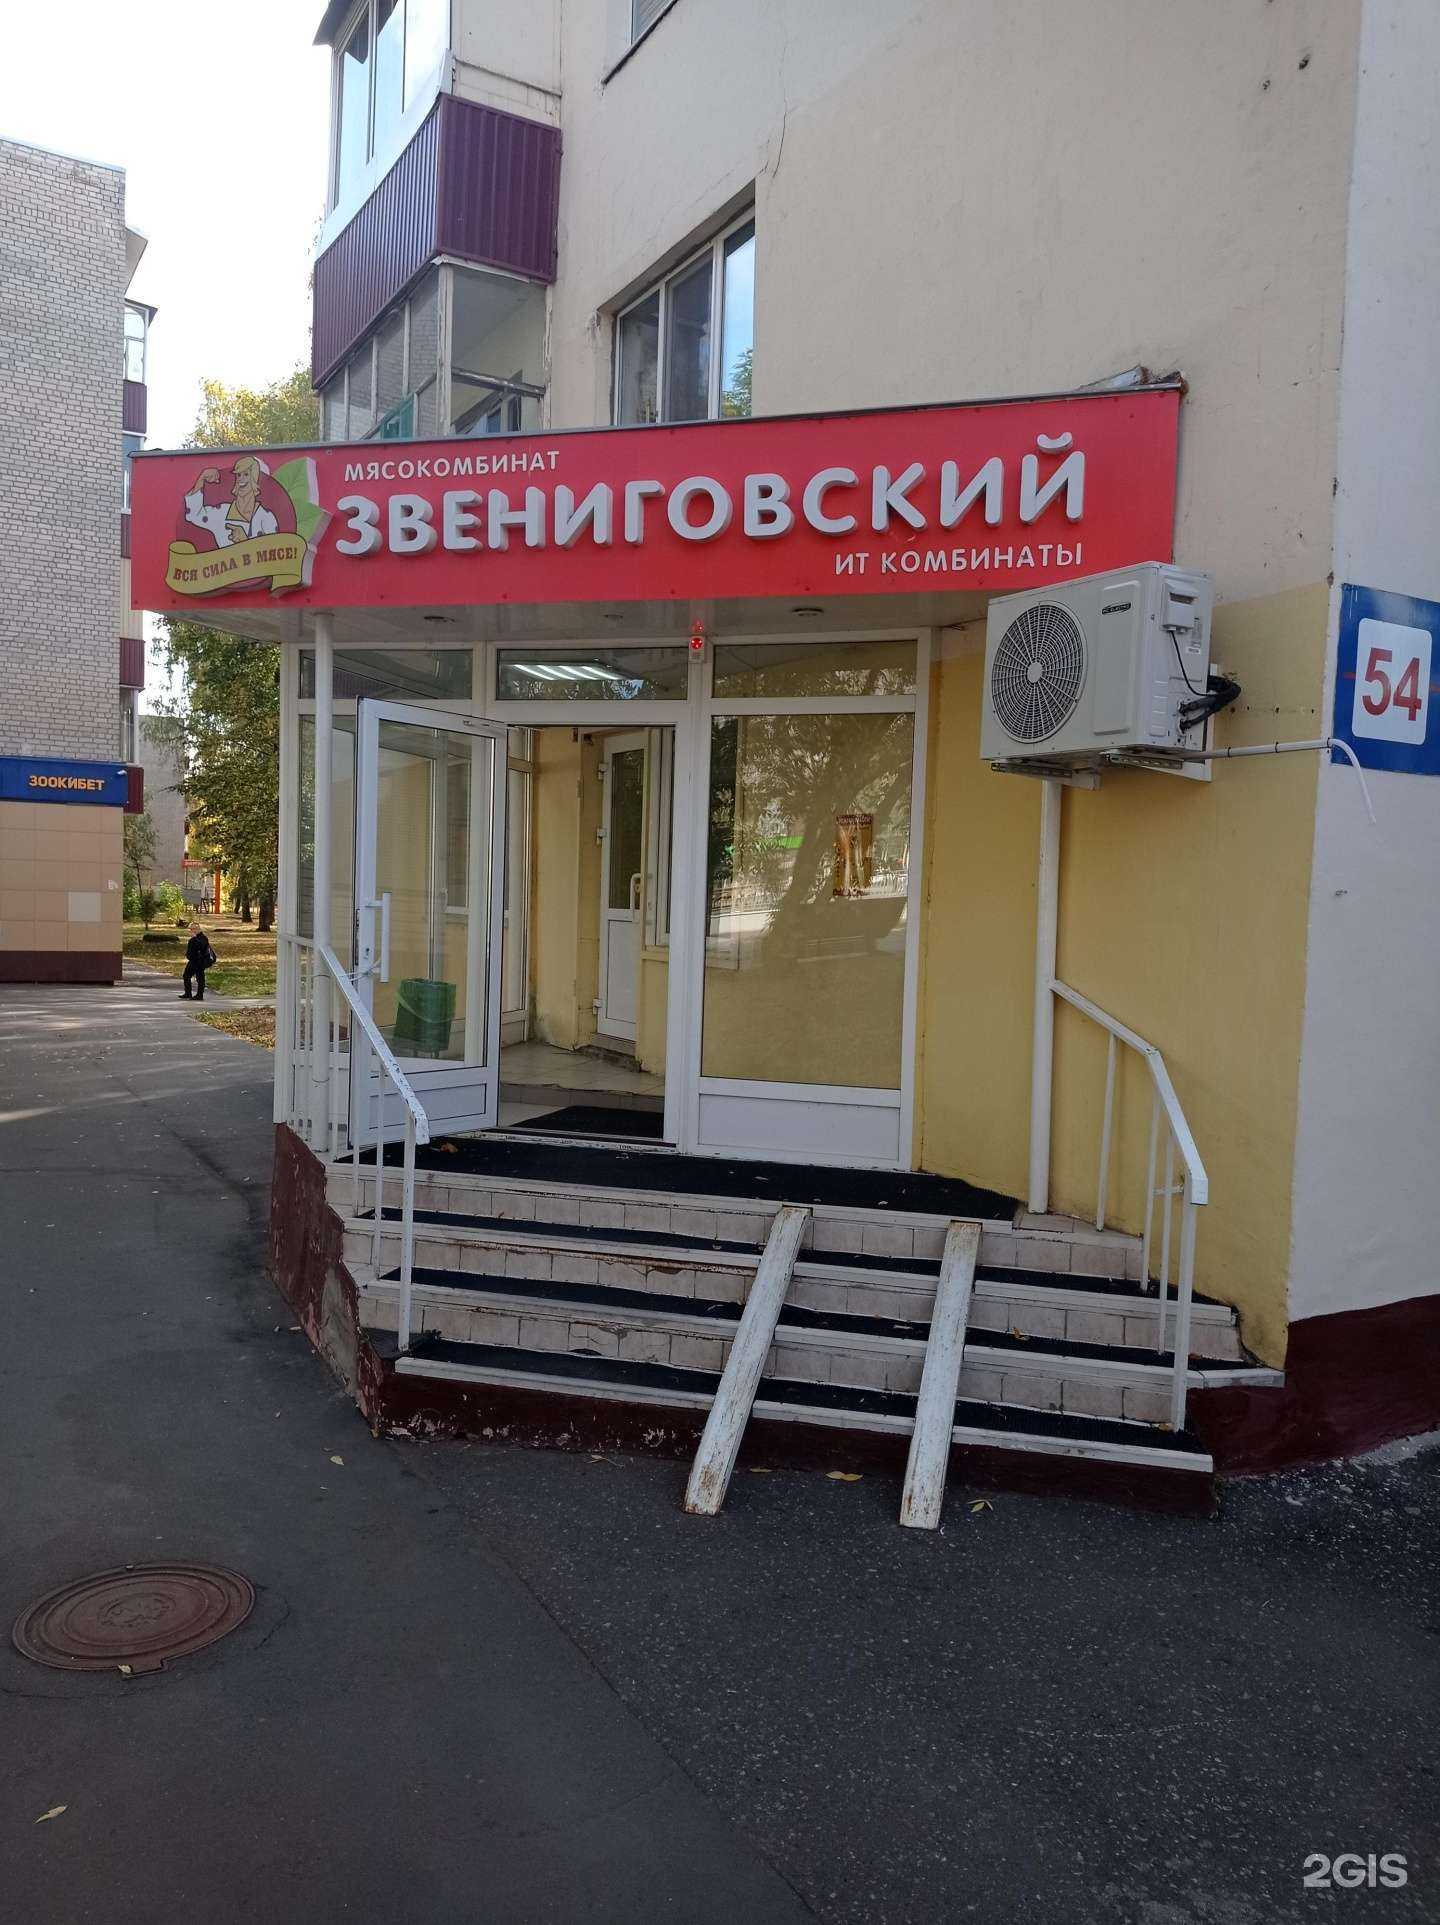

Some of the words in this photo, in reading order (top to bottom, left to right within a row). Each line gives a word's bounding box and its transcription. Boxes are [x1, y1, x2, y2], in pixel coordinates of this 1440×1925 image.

[344, 450, 560, 482] МЯСОКОМБИНАТ
[336, 432, 1086, 555] ЗВЕНИГОВСКИЙ
[173, 568, 198, 582] ВСЯ
[203, 558, 238, 579] СИЛА
[242, 554, 252, 566] В
[256, 547, 298, 563] МЯСЕ!
[834, 552, 869, 576] ИТ
[881, 543, 1083, 574] КОМБИНАТЫ
[1362, 647, 1422, 721] 54
